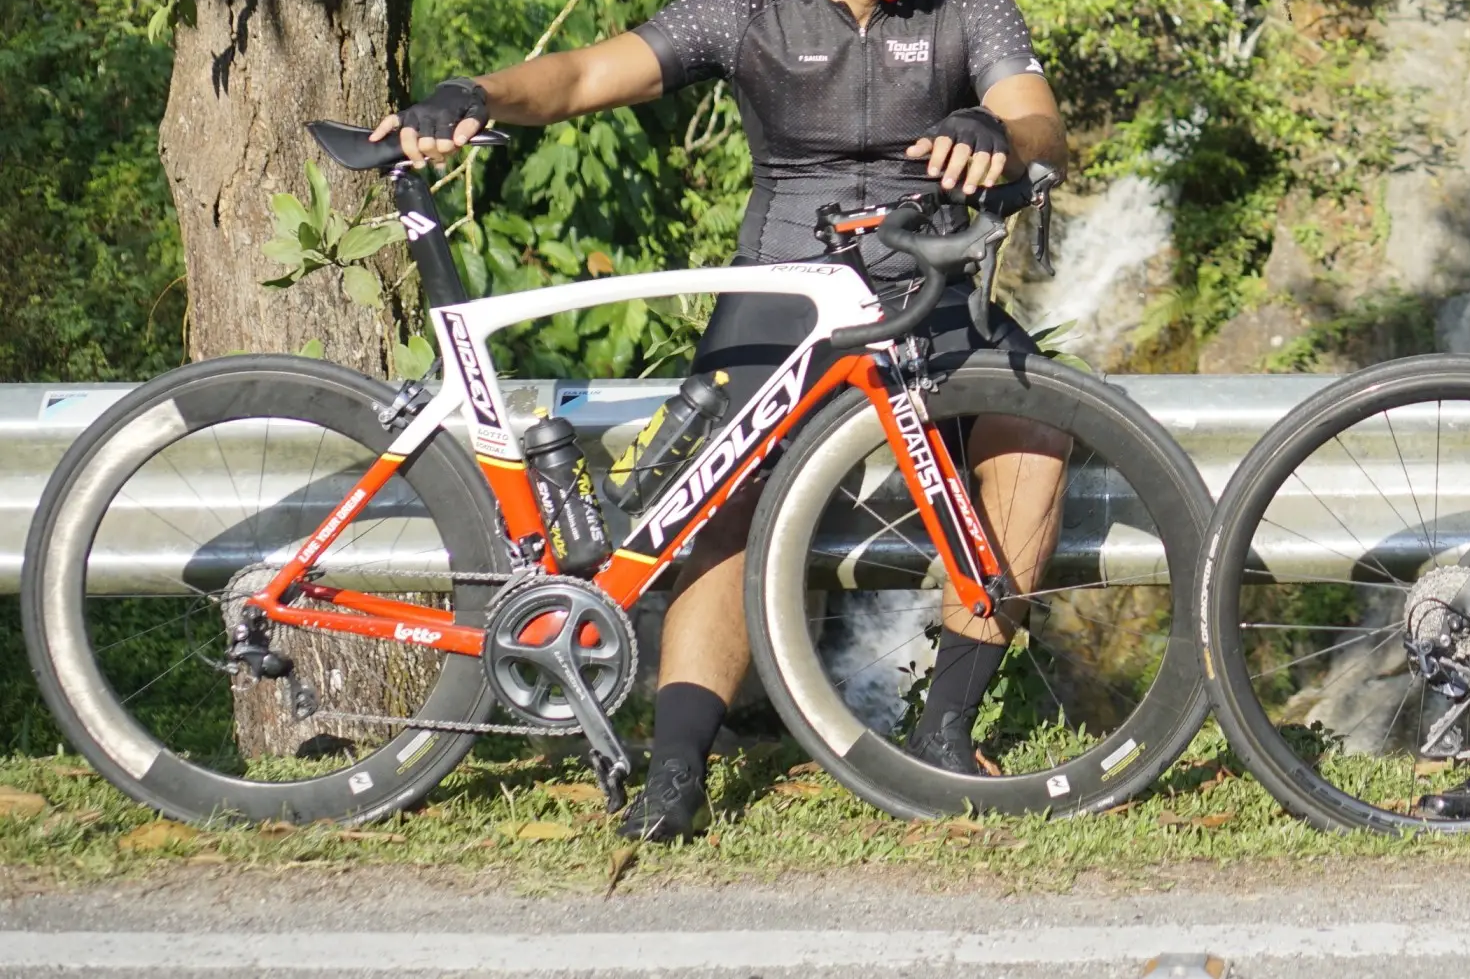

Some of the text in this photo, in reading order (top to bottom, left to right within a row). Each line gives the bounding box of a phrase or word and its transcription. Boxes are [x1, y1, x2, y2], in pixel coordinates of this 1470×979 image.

[886, 39, 929, 52] Touch
[770, 263, 843, 276] RIDLEY
[446, 313, 498, 422] RIDLEY
[477, 428, 509, 441] LOTTO
[649, 348, 813, 550] RIDLEY
[298, 489, 367, 564] LIVE YOUR DREAM
[393, 622, 442, 644] Lotto
